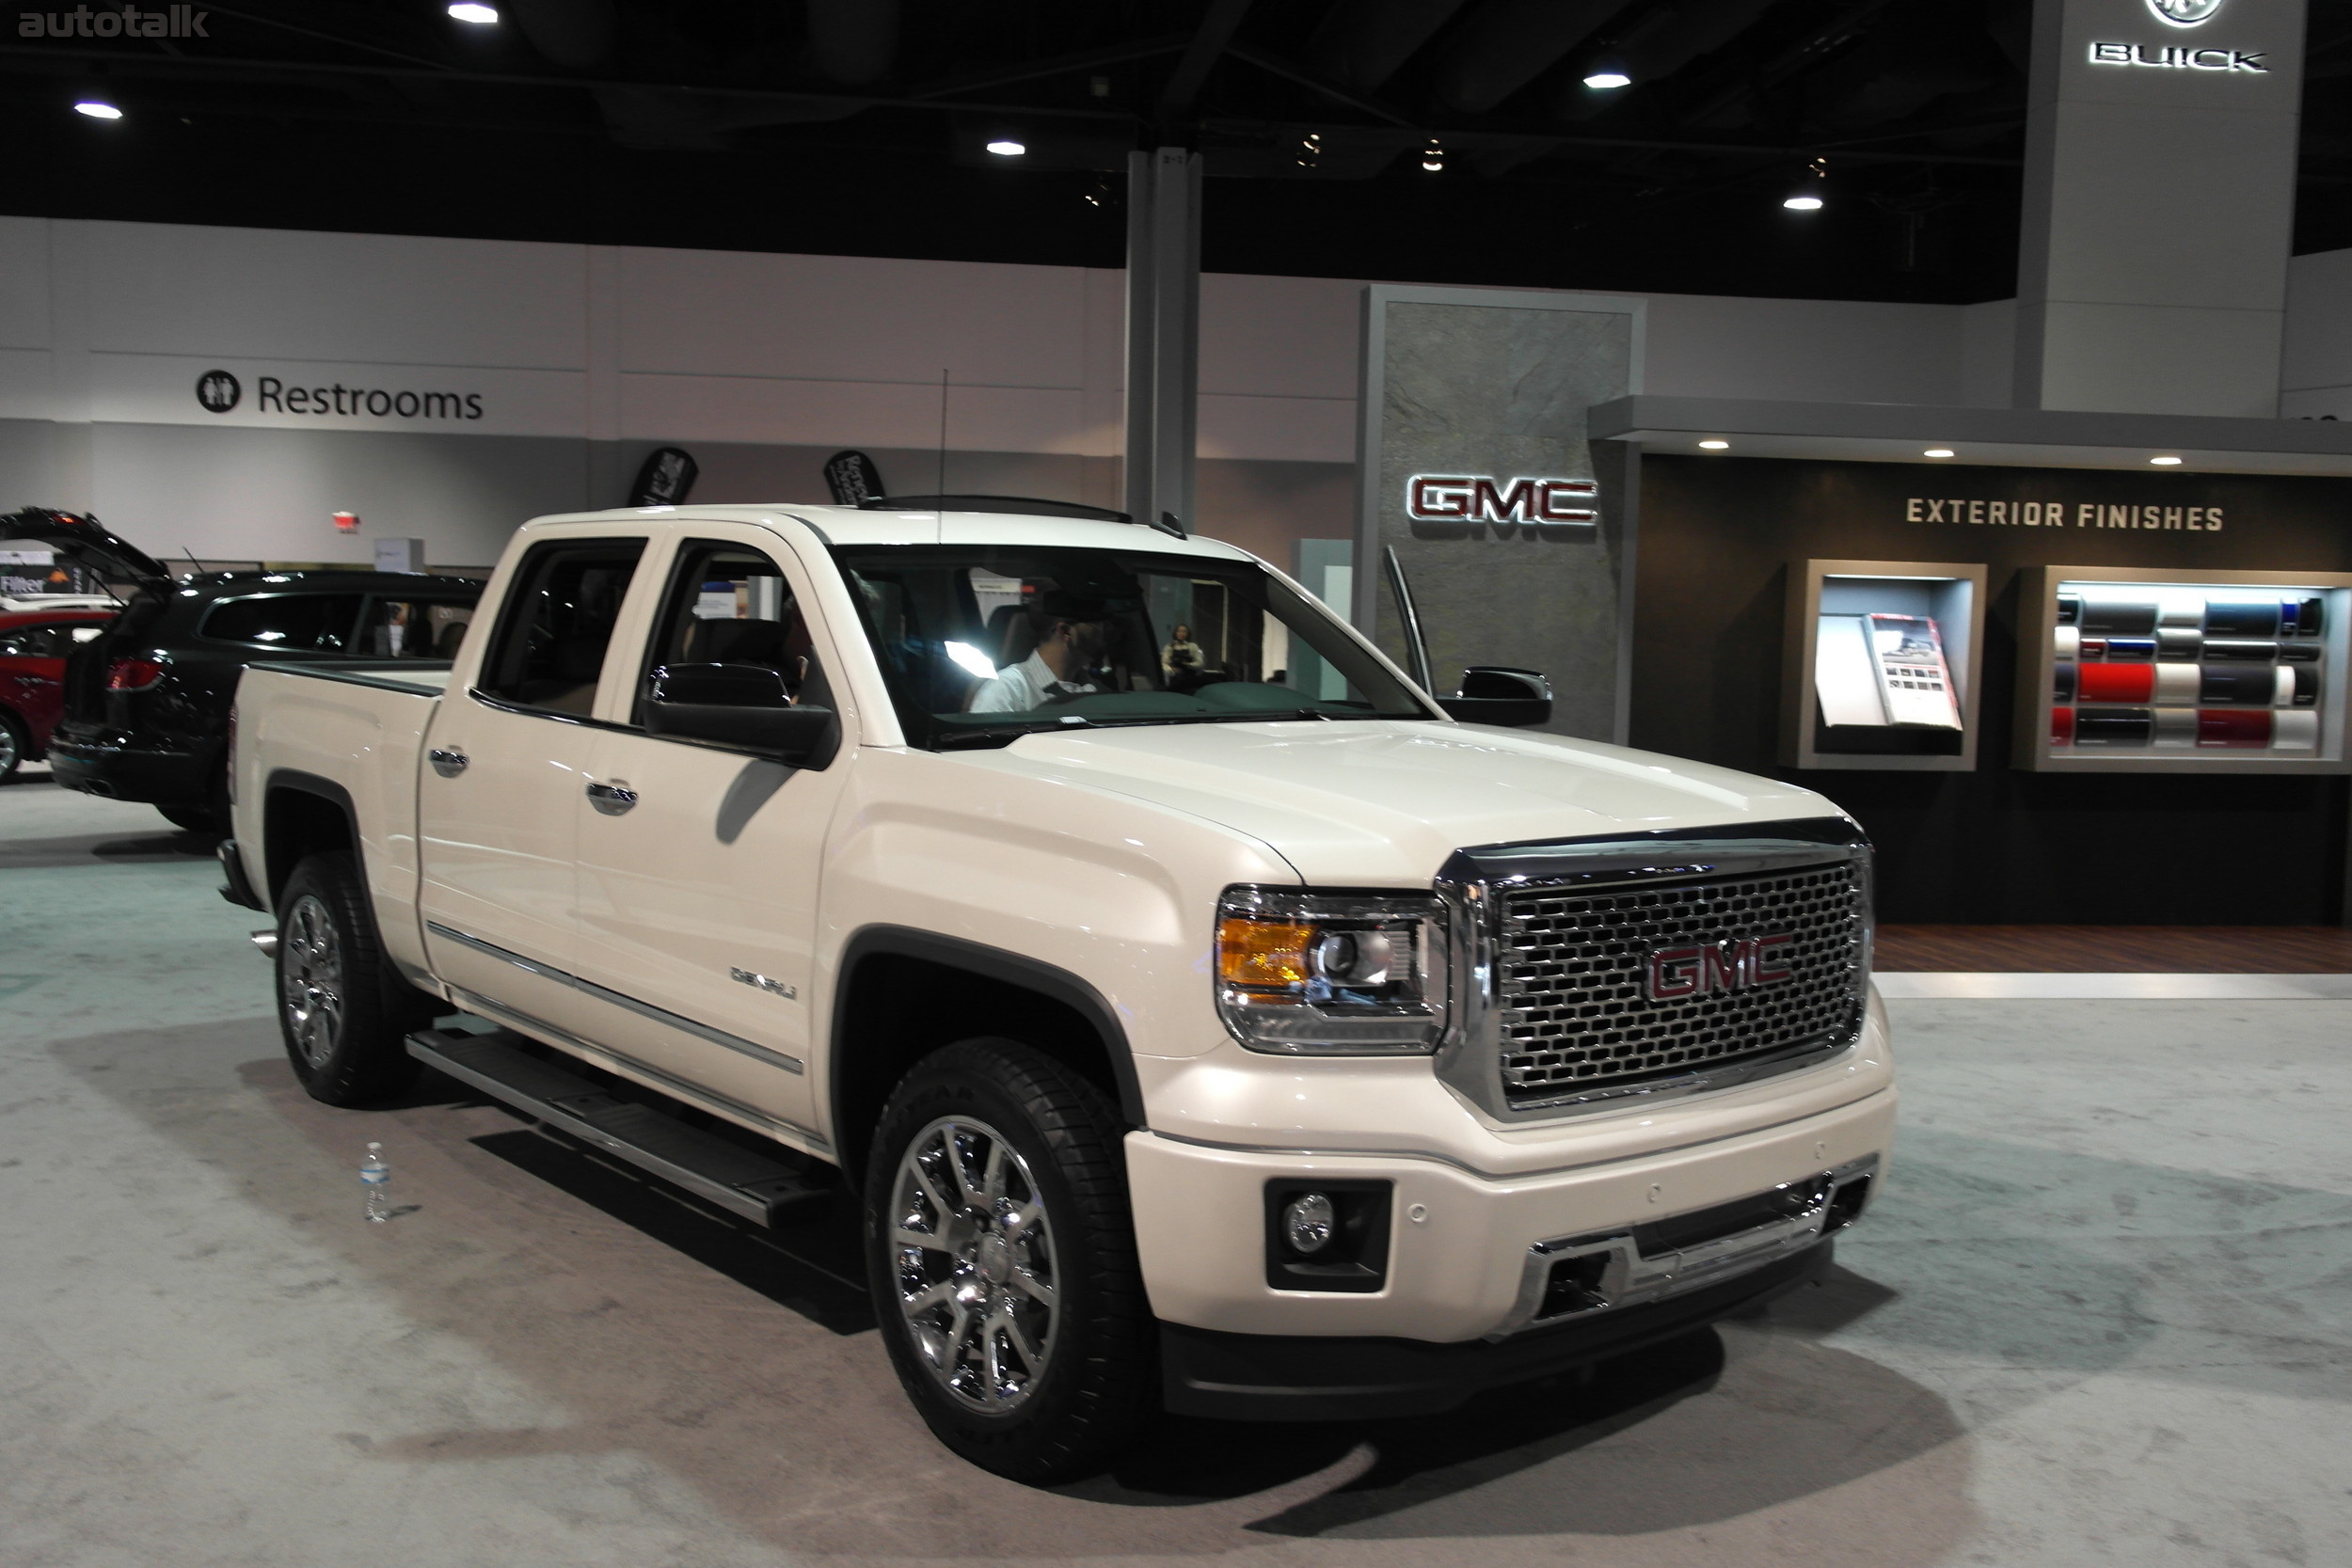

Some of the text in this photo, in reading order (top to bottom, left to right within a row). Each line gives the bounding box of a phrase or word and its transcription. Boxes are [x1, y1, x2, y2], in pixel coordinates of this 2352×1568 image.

[2090, 42, 2271, 73] BUICK
[260, 377, 484, 420] Restrooms
[1406, 474, 1598, 527] GMC
[1906, 498, 2224, 532] EXTERIOR FINISHES
[1649, 934, 1794, 1002] GMC
